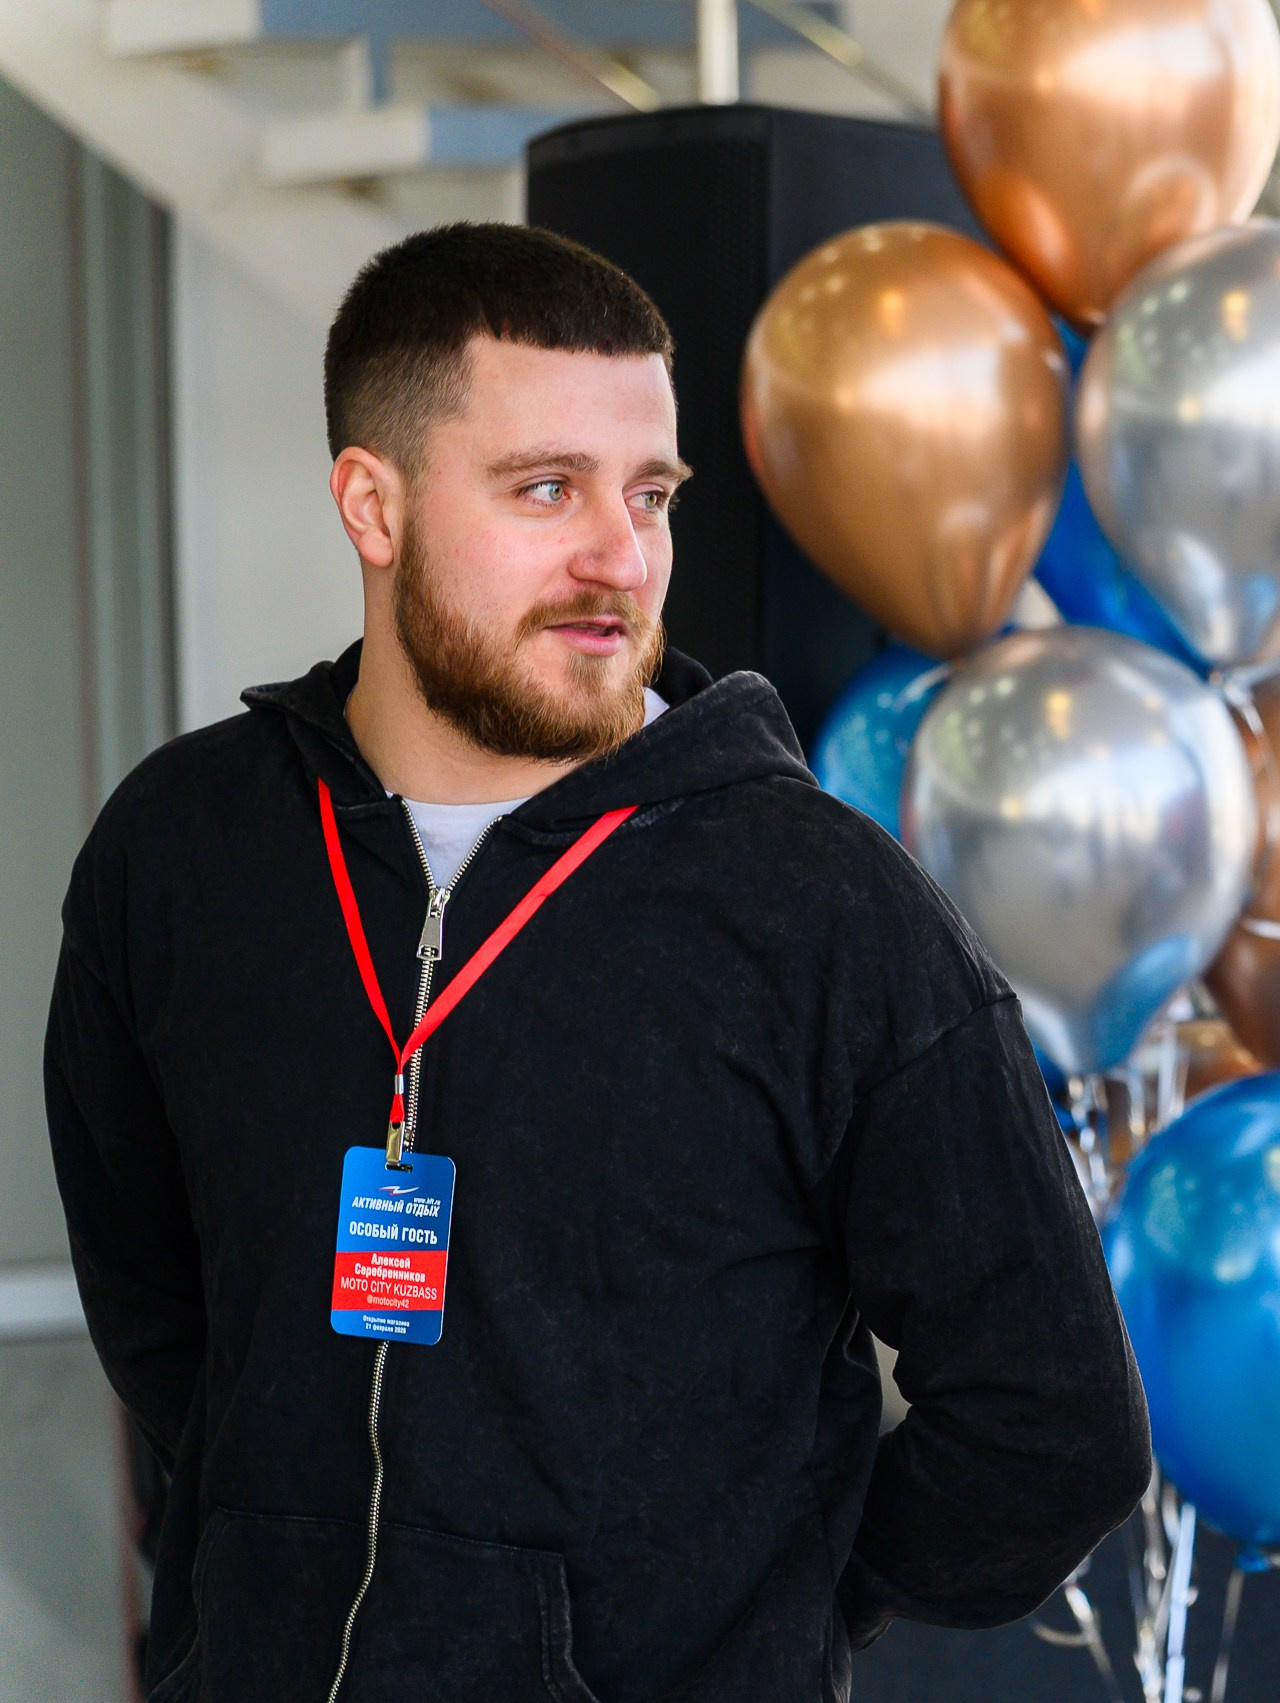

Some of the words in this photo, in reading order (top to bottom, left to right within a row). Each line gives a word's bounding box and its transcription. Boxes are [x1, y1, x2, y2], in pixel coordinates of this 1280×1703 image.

[352, 1196, 404, 1213] АКТИВНЫЙ
[406, 1202, 441, 1217] ОТДЫХ
[349, 1220, 398, 1241] ОСОБЫЙ
[401, 1227, 438, 1245] ГОСТЬ
[371, 1253, 411, 1269] Алексей
[354, 1263, 426, 1283] Серебренников
[340, 1277, 369, 1291] MOTO
[370, 1280, 392, 1294] CITY
[393, 1283, 438, 1301] KUZBASS
[366, 1295, 410, 1309] @motocity42
